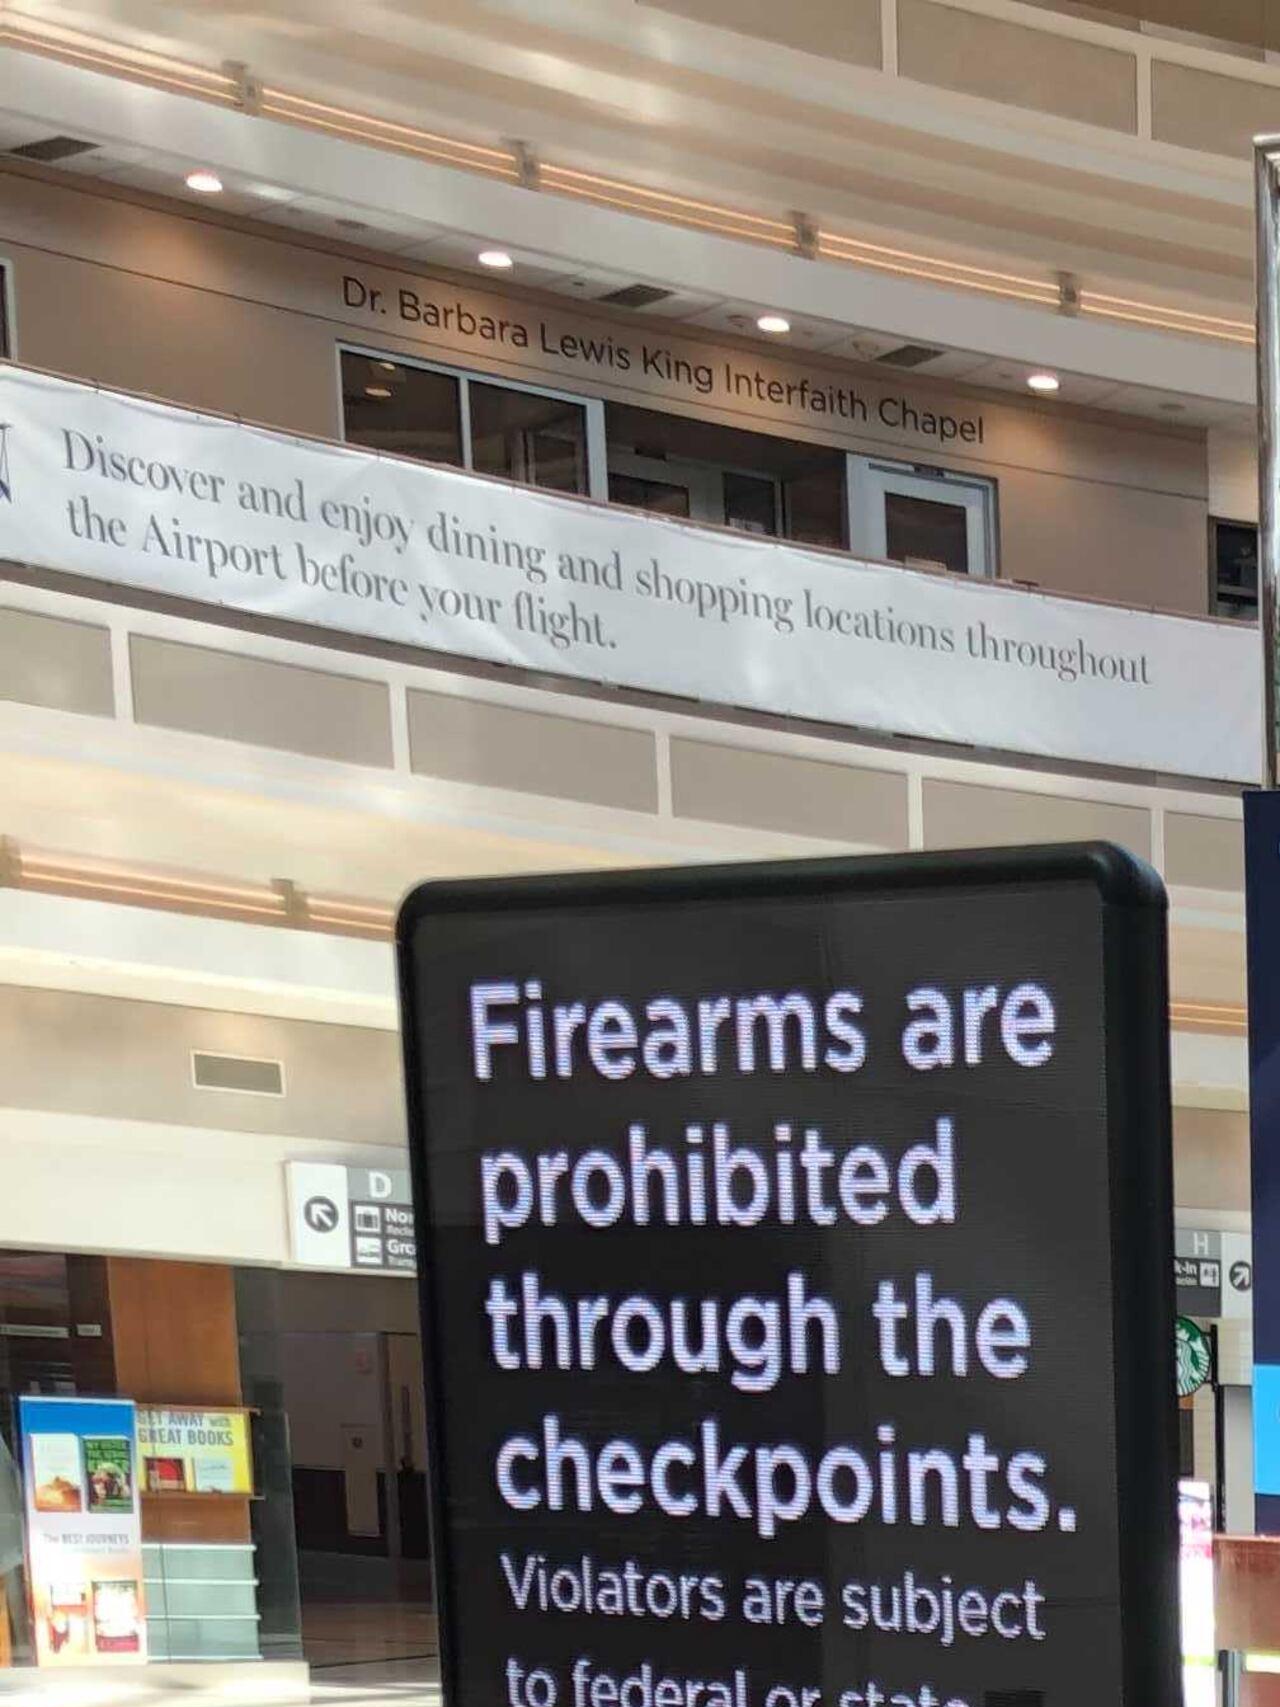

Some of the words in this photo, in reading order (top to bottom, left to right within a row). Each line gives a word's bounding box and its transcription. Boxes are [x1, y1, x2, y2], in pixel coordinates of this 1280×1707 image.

[342, 275, 386, 315] Dr.
[400, 290, 529, 348] Barbara
[541, 322, 631, 370] Lewis
[642, 345, 713, 393] King
[725, 364, 868, 422] Interfaith
[878, 396, 984, 445] Chapel
[61, 427, 226, 503] Discover
[238, 478, 307, 523] and
[321, 496, 411, 554] enjoy
[428, 511, 545, 584] dining
[558, 550, 622, 592] and
[636, 557, 794, 634] shopping
[805, 589, 955, 654] locations
[968, 621, 1151, 687] throughout
[66, 495, 128, 548] the
[142, 513, 287, 579] Airport
[300, 541, 409, 606] before
[419, 582, 502, 624] your
[513, 589, 617, 650] flight.
[468, 978, 868, 1081] Firearms
[902, 980, 1056, 1070] are
[368, 1171, 392, 1198] D
[479, 1115, 957, 1245] prohibited
[1193, 1232, 1209, 1256] H
[485, 1272, 842, 1394] through
[872, 1273, 1032, 1379] the
[168, 1412, 204, 1428] AWAY
[187, 1429, 234, 1446] BOOKS
[496, 1414, 1078, 1539] checkpoints.
[501, 1552, 726, 1622] Violators
[743, 1579, 825, 1626] are
[842, 1571, 1046, 1646] subject
